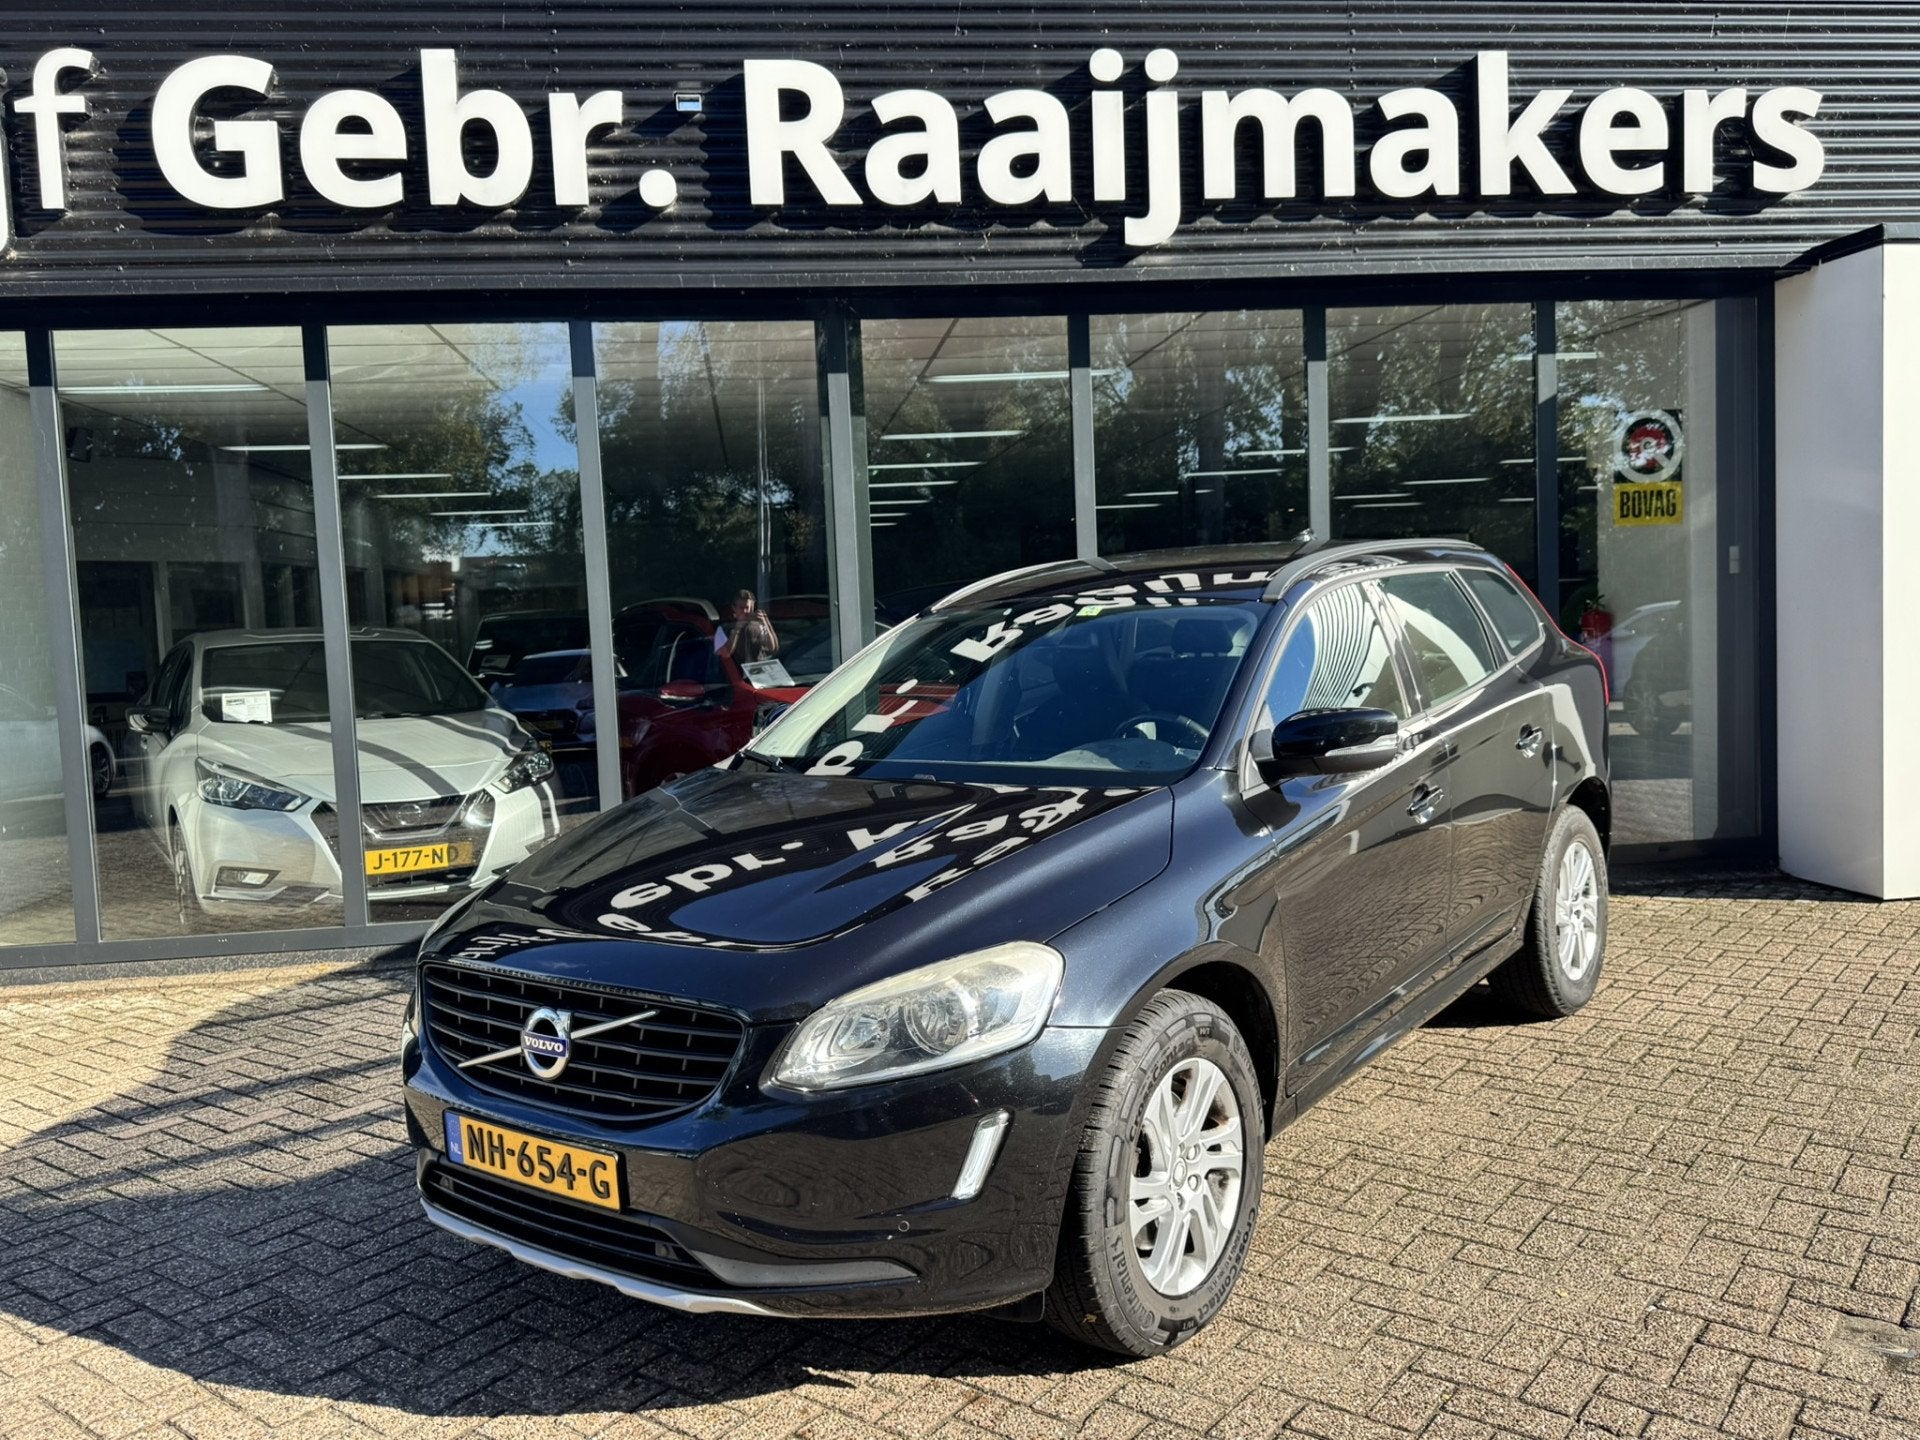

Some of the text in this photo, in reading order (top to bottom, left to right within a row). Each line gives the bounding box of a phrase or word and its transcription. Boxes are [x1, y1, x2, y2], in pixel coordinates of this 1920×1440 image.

[151, 48, 678, 210] Gebr.
[743, 48, 1825, 246] Raaijmakers
[1619, 488, 1677, 519] BOVAG
[524, 1035, 564, 1053] VOLVO
[450, 1140, 462, 1155] NL
[466, 1123, 611, 1200] NH-654-G
